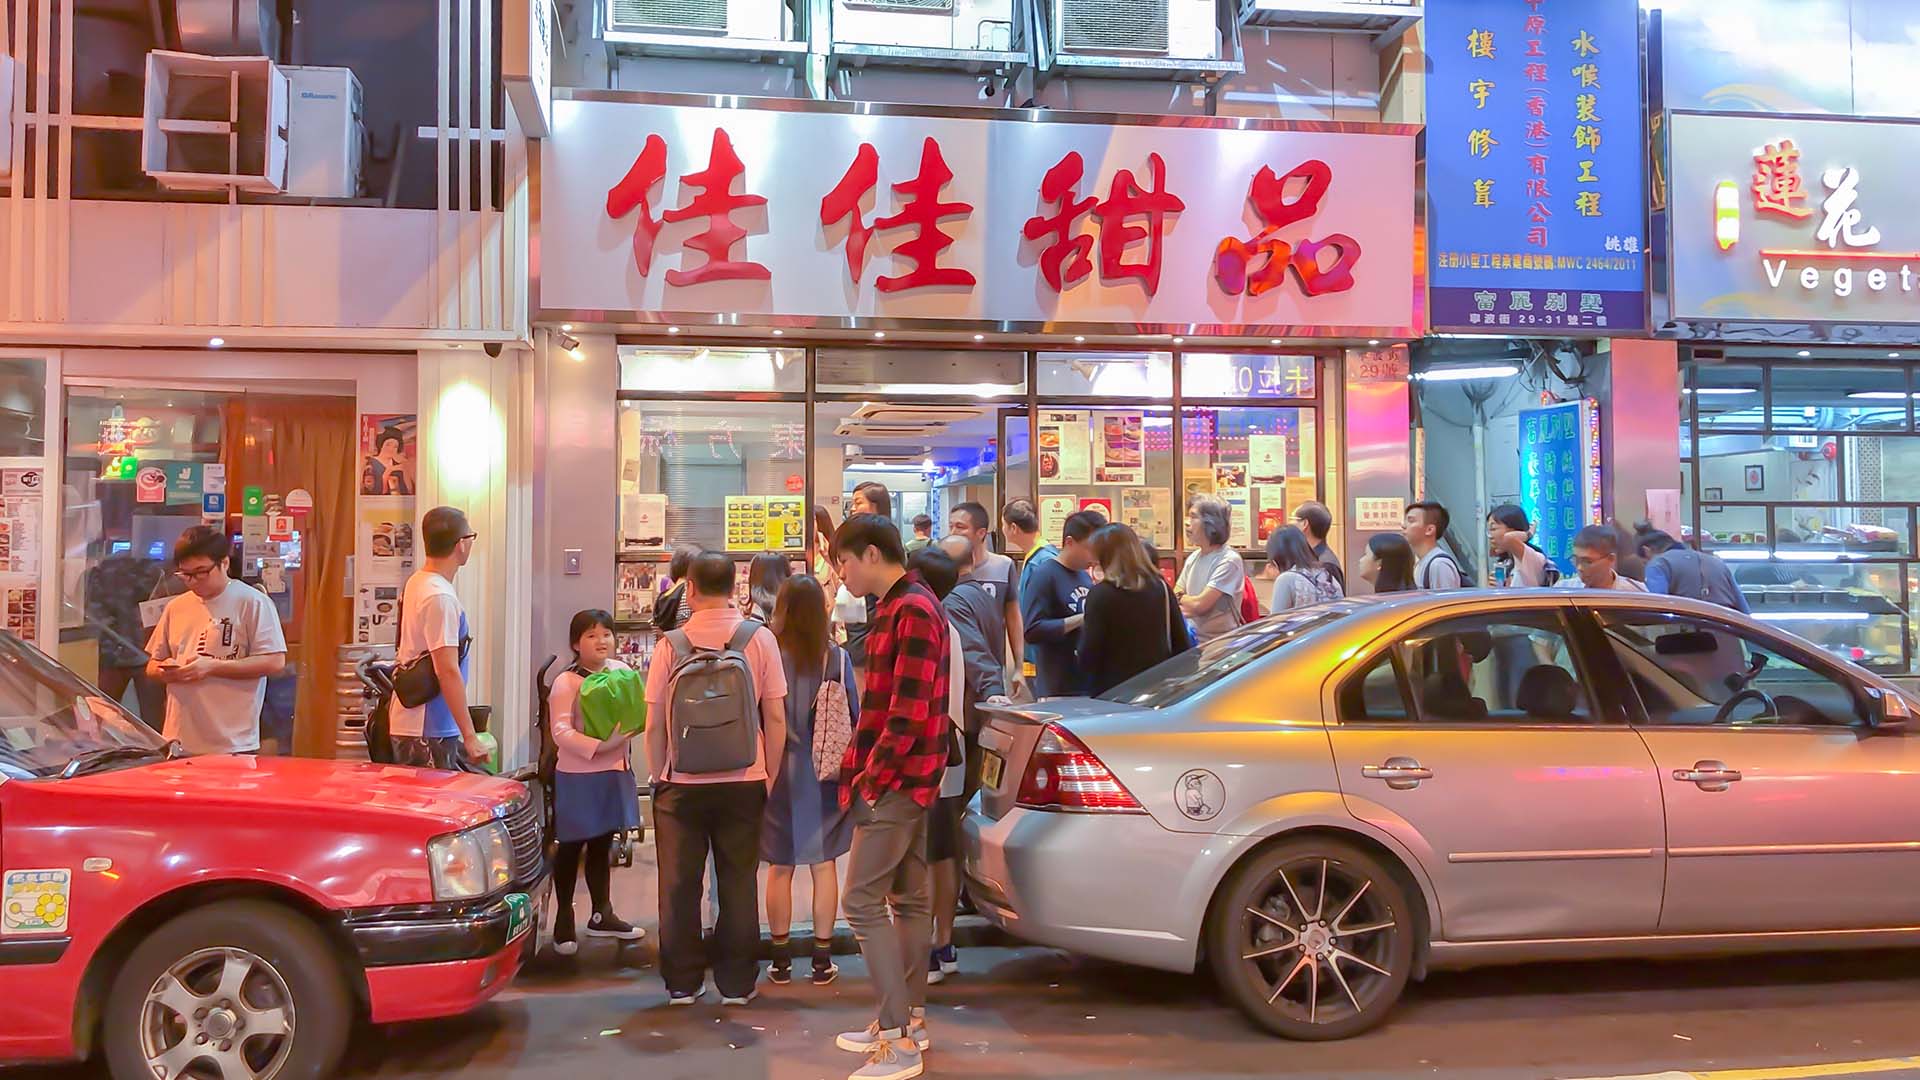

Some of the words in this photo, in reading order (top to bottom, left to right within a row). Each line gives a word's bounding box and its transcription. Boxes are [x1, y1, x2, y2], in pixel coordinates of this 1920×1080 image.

[1466, 28, 1499, 209] 樓宇修葺
[1571, 29, 1603, 217] 水喉裝飾工程
[605, 127, 1362, 297] 佳佳甜品
[1752, 138, 1881, 248] 蓮花
[1474, 290, 1604, 313] 富麗別墅
[1519, 314, 1562, 325] 29-31
[1762, 259, 1920, 297] Veget
